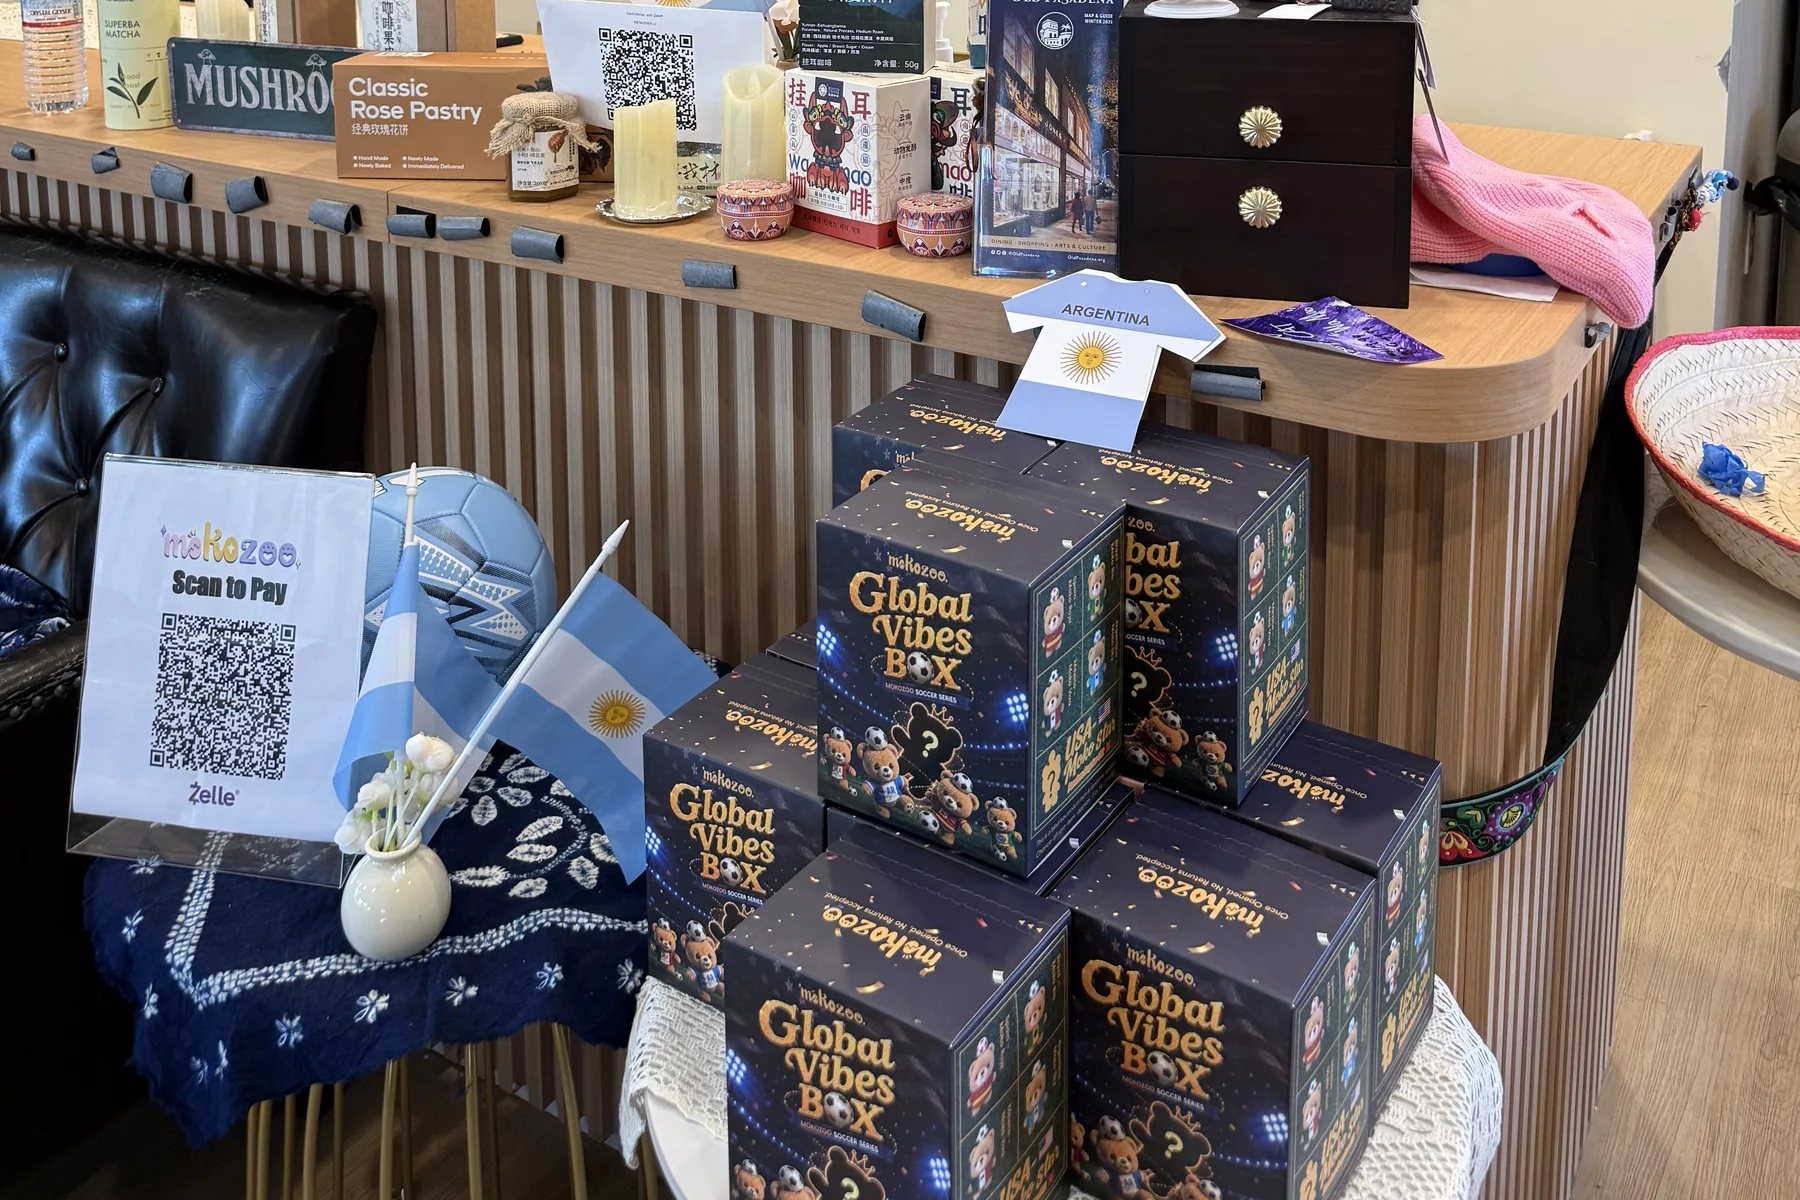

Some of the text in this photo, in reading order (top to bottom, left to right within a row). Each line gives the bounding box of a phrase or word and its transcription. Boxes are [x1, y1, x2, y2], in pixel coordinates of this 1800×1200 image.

[52, 8, 72, 16] GEYSER
[105, 20, 141, 28] SUPERBA
[106, 30, 141, 38] MATCHA
[802, 58, 832, 66] 挂耳咖啡
[904, 60, 919, 70] 50g
[183, 62, 335, 115] MUSHRO
[349, 77, 428, 97] Classic
[788, 77, 872, 121] 挂 耳
[350, 100, 482, 125] Rose Pastry
[950, 87, 972, 117] 耳
[352, 123, 408, 136] 经典玫瑰花饼
[850, 188, 872, 217] 啡
[1061, 303, 1150, 326] ARGENTINA
[1135, 455, 1164, 466] Returns
[1212, 475, 1234, 484] Once
[942, 500, 970, 511] Returns
[1018, 522, 1039, 532] Once
[1126, 532, 1182, 569] bal
[172, 569, 288, 606] Scan to Pay
[1125, 564, 1181, 599] bes
[849, 571, 975, 623] Global
[872, 614, 972, 655] Vibes
[1147, 636, 1165, 646] SERIES
[884, 647, 962, 691] BOX
[886, 682, 957, 704] MOKOZOO SOCCER SERIES
[760, 710, 784, 723] Returns
[922, 730, 939, 758] ?
[1261, 768, 1346, 804] mokoz
[1345, 788, 1368, 799] Once
[669, 782, 775, 835] Global
[690, 823, 775, 864] Vibes
[700, 852, 767, 895] BOX
[1176, 868, 1210, 888] Returns
[727, 888, 747, 901] SOCCER
[748, 894, 764, 906] SERIES
[1210, 882, 1224, 892] No
[862, 906, 894, 926] Returns
[895, 920, 907, 929] No
[1264, 907, 1289, 920] Once
[945, 942, 968, 958] Once
[1081, 959, 1226, 1034] Global
[758, 999, 897, 1070] Global
[1107, 1006, 1224, 1067] Vibes
[785, 1047, 896, 1105] Vibes
[1120, 1040, 1212, 1100] BOX
[1156, 1086, 1183, 1102] SOCCER
[1184, 1095, 1204, 1111] SERIES
[798, 1082, 885, 1142] BOX
[833, 1131, 859, 1145] SOCCER
[859, 1138, 879, 1153] SERIES
[1164, 1131, 1183, 1159] ?
